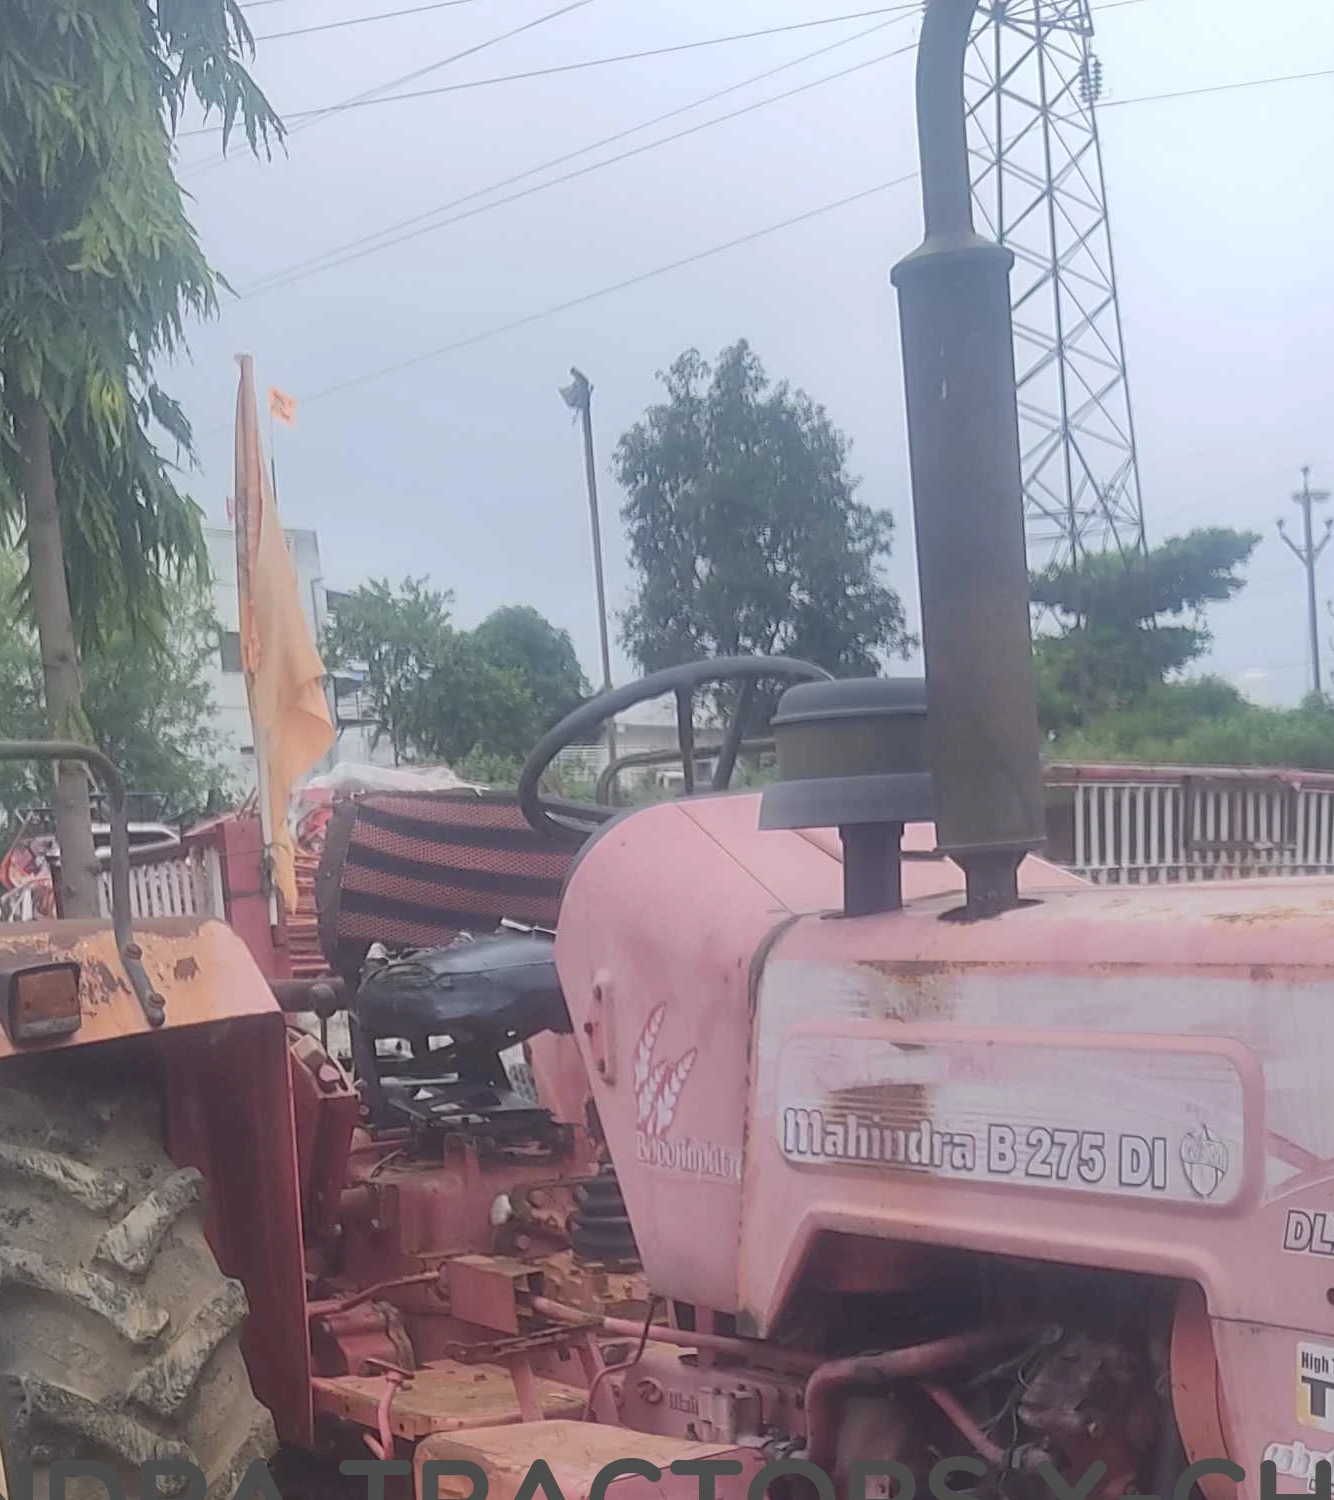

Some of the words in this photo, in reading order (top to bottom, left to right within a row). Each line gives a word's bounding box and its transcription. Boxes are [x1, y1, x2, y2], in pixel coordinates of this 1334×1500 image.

[783, 1107, 976, 1171] Mahindra
[987, 1124, 1017, 1174] B
[1025, 1127, 1106, 1183] 275
[1119, 1135, 1167, 1190] DI
[1300, 1351, 1329, 1374] High
